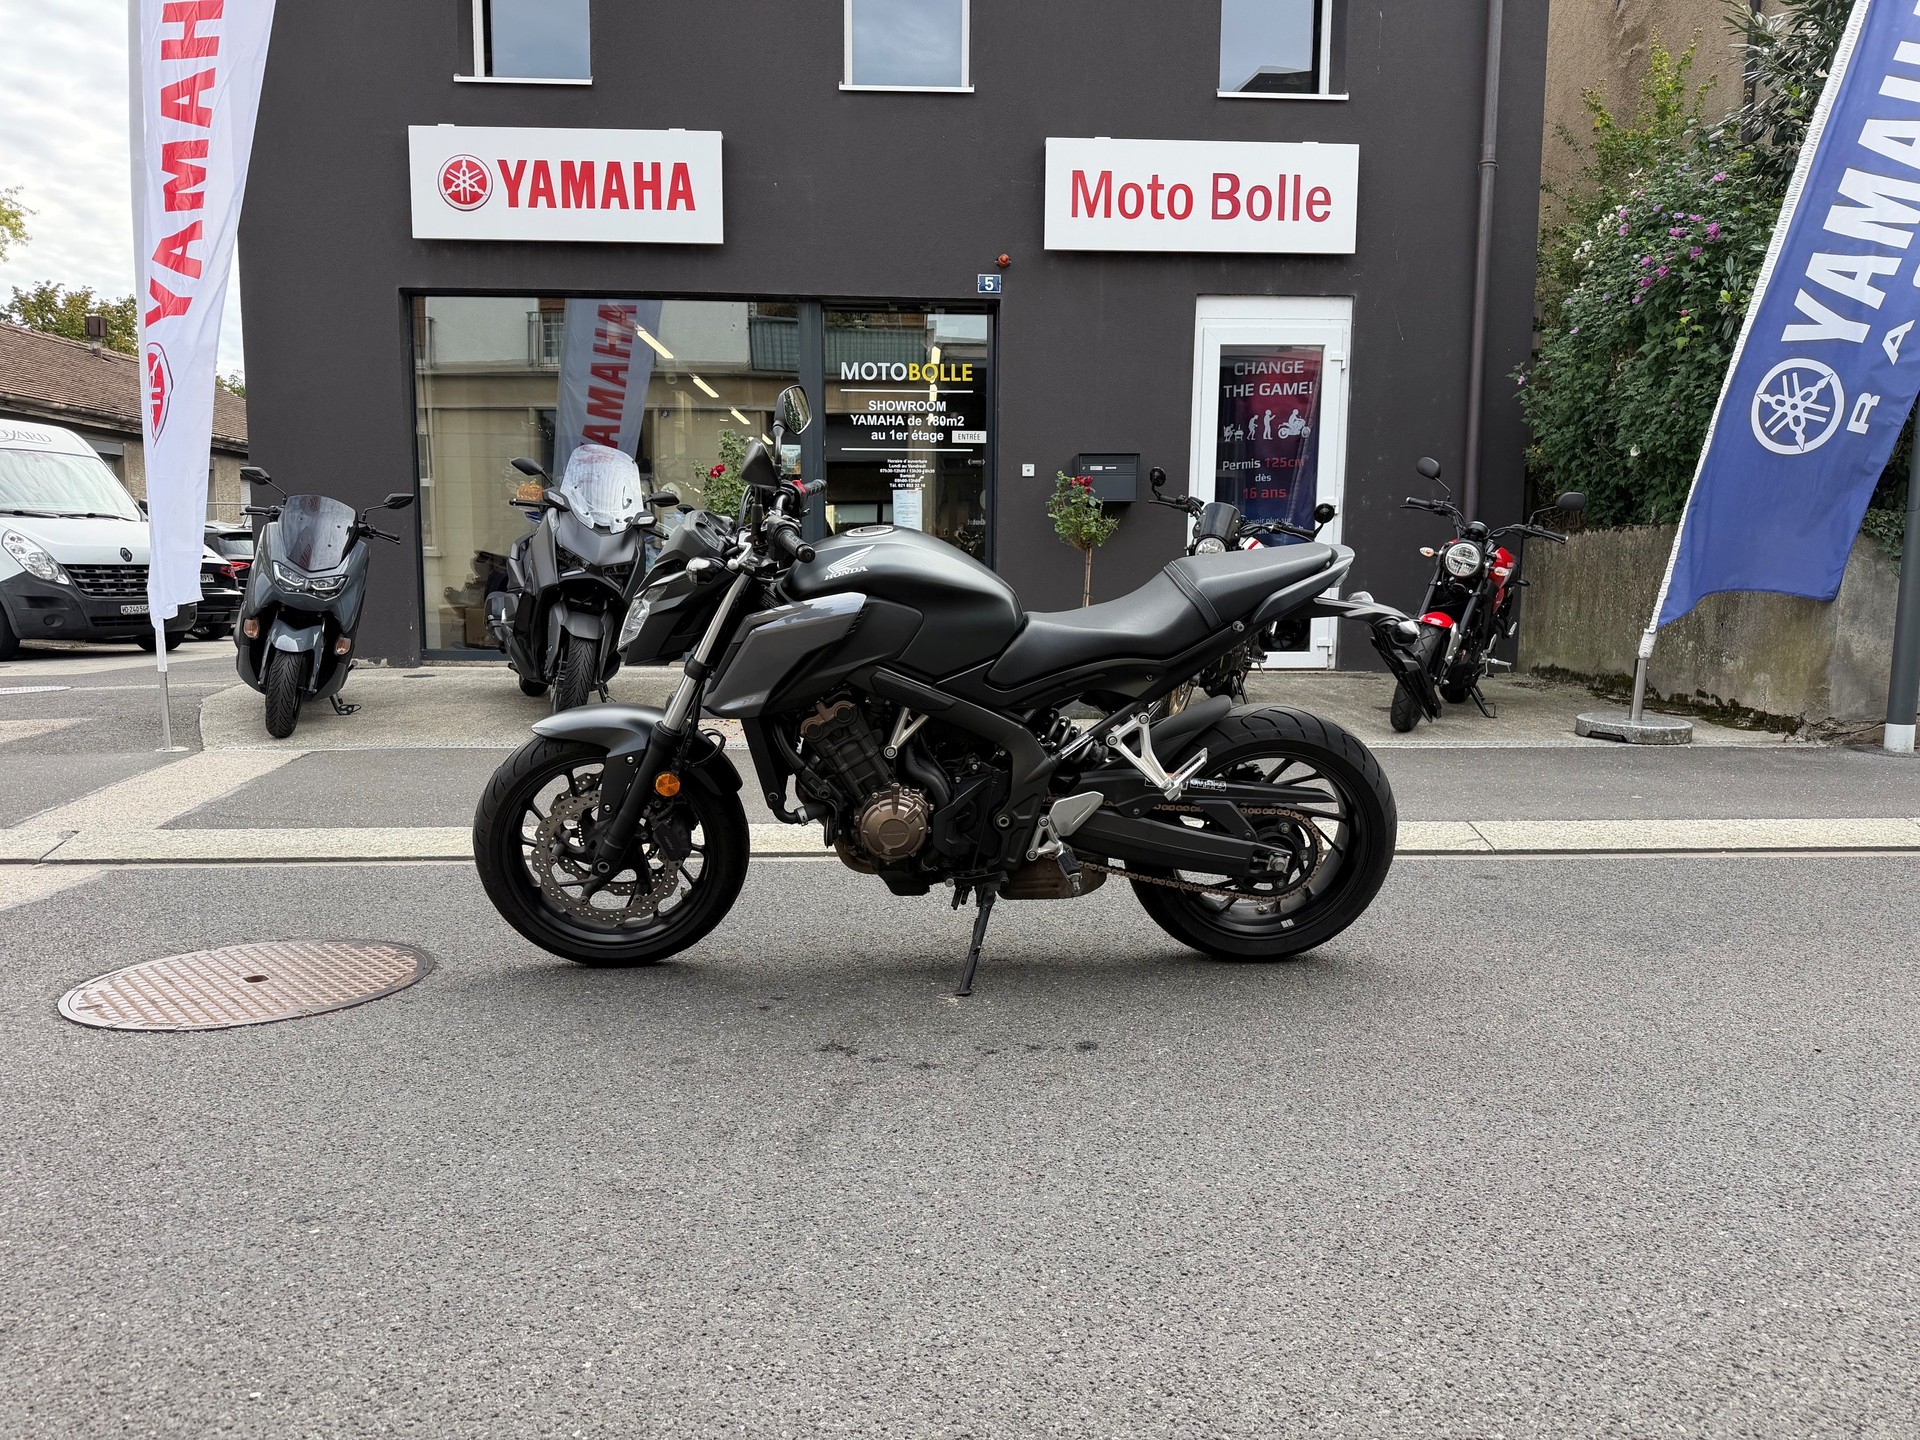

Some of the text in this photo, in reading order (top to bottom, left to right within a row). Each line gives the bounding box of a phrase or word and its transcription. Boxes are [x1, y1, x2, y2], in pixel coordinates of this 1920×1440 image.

[1780, 0, 1920, 343] YAMA
[497, 159, 696, 211] YAMAHA
[1070, 169, 1332, 222] Moto Bolle
[984, 276, 994, 291] 5
[840, 361, 974, 382] MOTOBOLLE
[1234, 360, 1305, 376] CHANGE
[580, 304, 638, 448] AMAHA
[1223, 381, 1313, 398] THE GAME!
[868, 400, 947, 412] SHOWROOM
[850, 414, 905, 426] YAMAHA
[907, 415, 923, 426] de
[871, 430, 945, 443] au 1er étage
[957, 432, 981, 441] ENTRÉE
[1222, 458, 1261, 471] Permis
[1255, 473, 1272, 482] dès
[1243, 487, 1287, 499] 16 ans
[824, 566, 868, 580] HONDA
